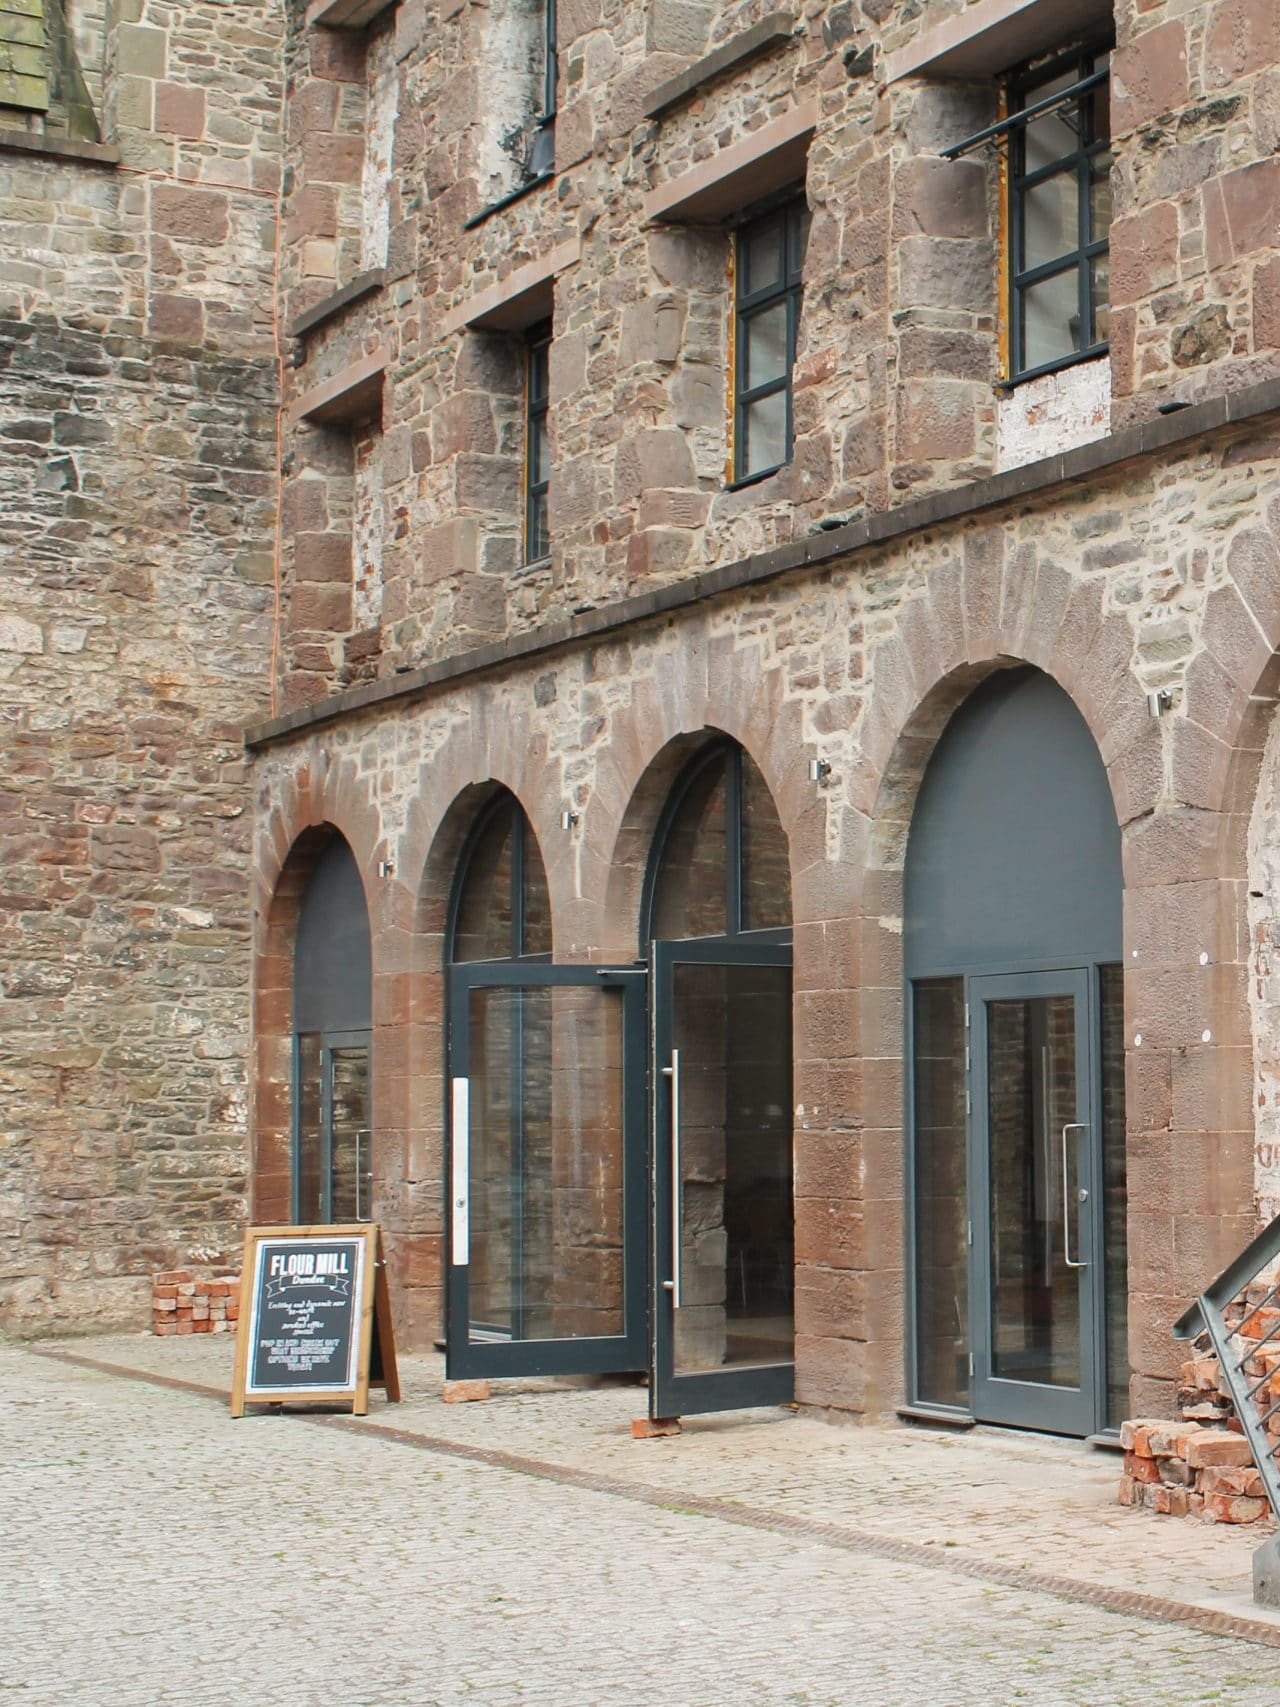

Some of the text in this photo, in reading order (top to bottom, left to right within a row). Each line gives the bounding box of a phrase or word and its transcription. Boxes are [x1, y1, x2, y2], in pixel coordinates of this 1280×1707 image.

[270, 1252, 349, 1276] FLOUR MILL
[292, 1275, 325, 1285] Dundee
